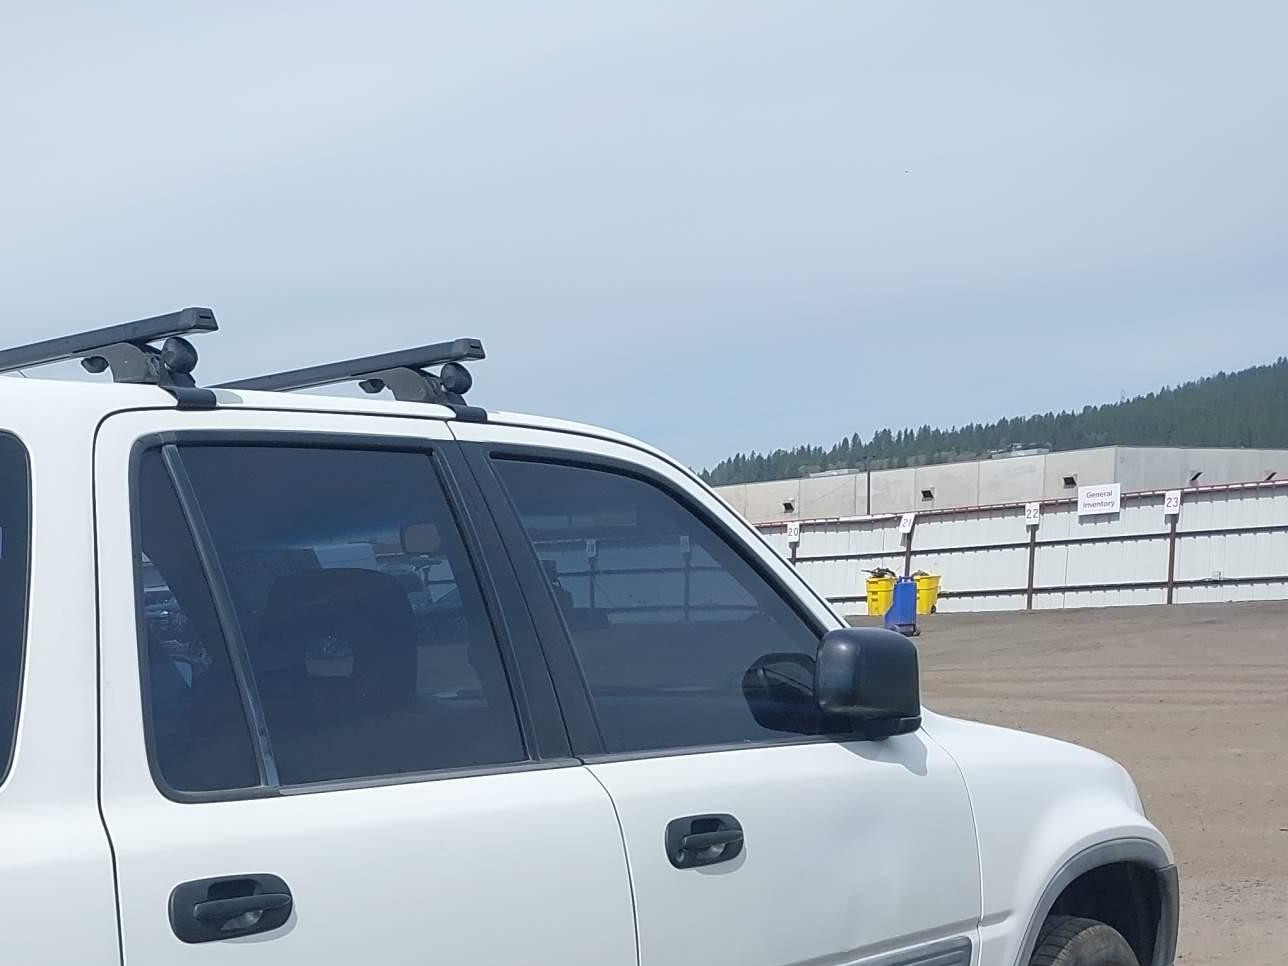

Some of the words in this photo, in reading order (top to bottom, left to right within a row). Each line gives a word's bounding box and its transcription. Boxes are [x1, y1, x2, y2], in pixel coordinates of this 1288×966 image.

[1086, 490, 1113, 499] General
[1082, 500, 1115, 509] Inventory
[1166, 497, 1179, 508] 23
[1026, 508, 1039, 519] 22
[787, 526, 799, 537] 20
